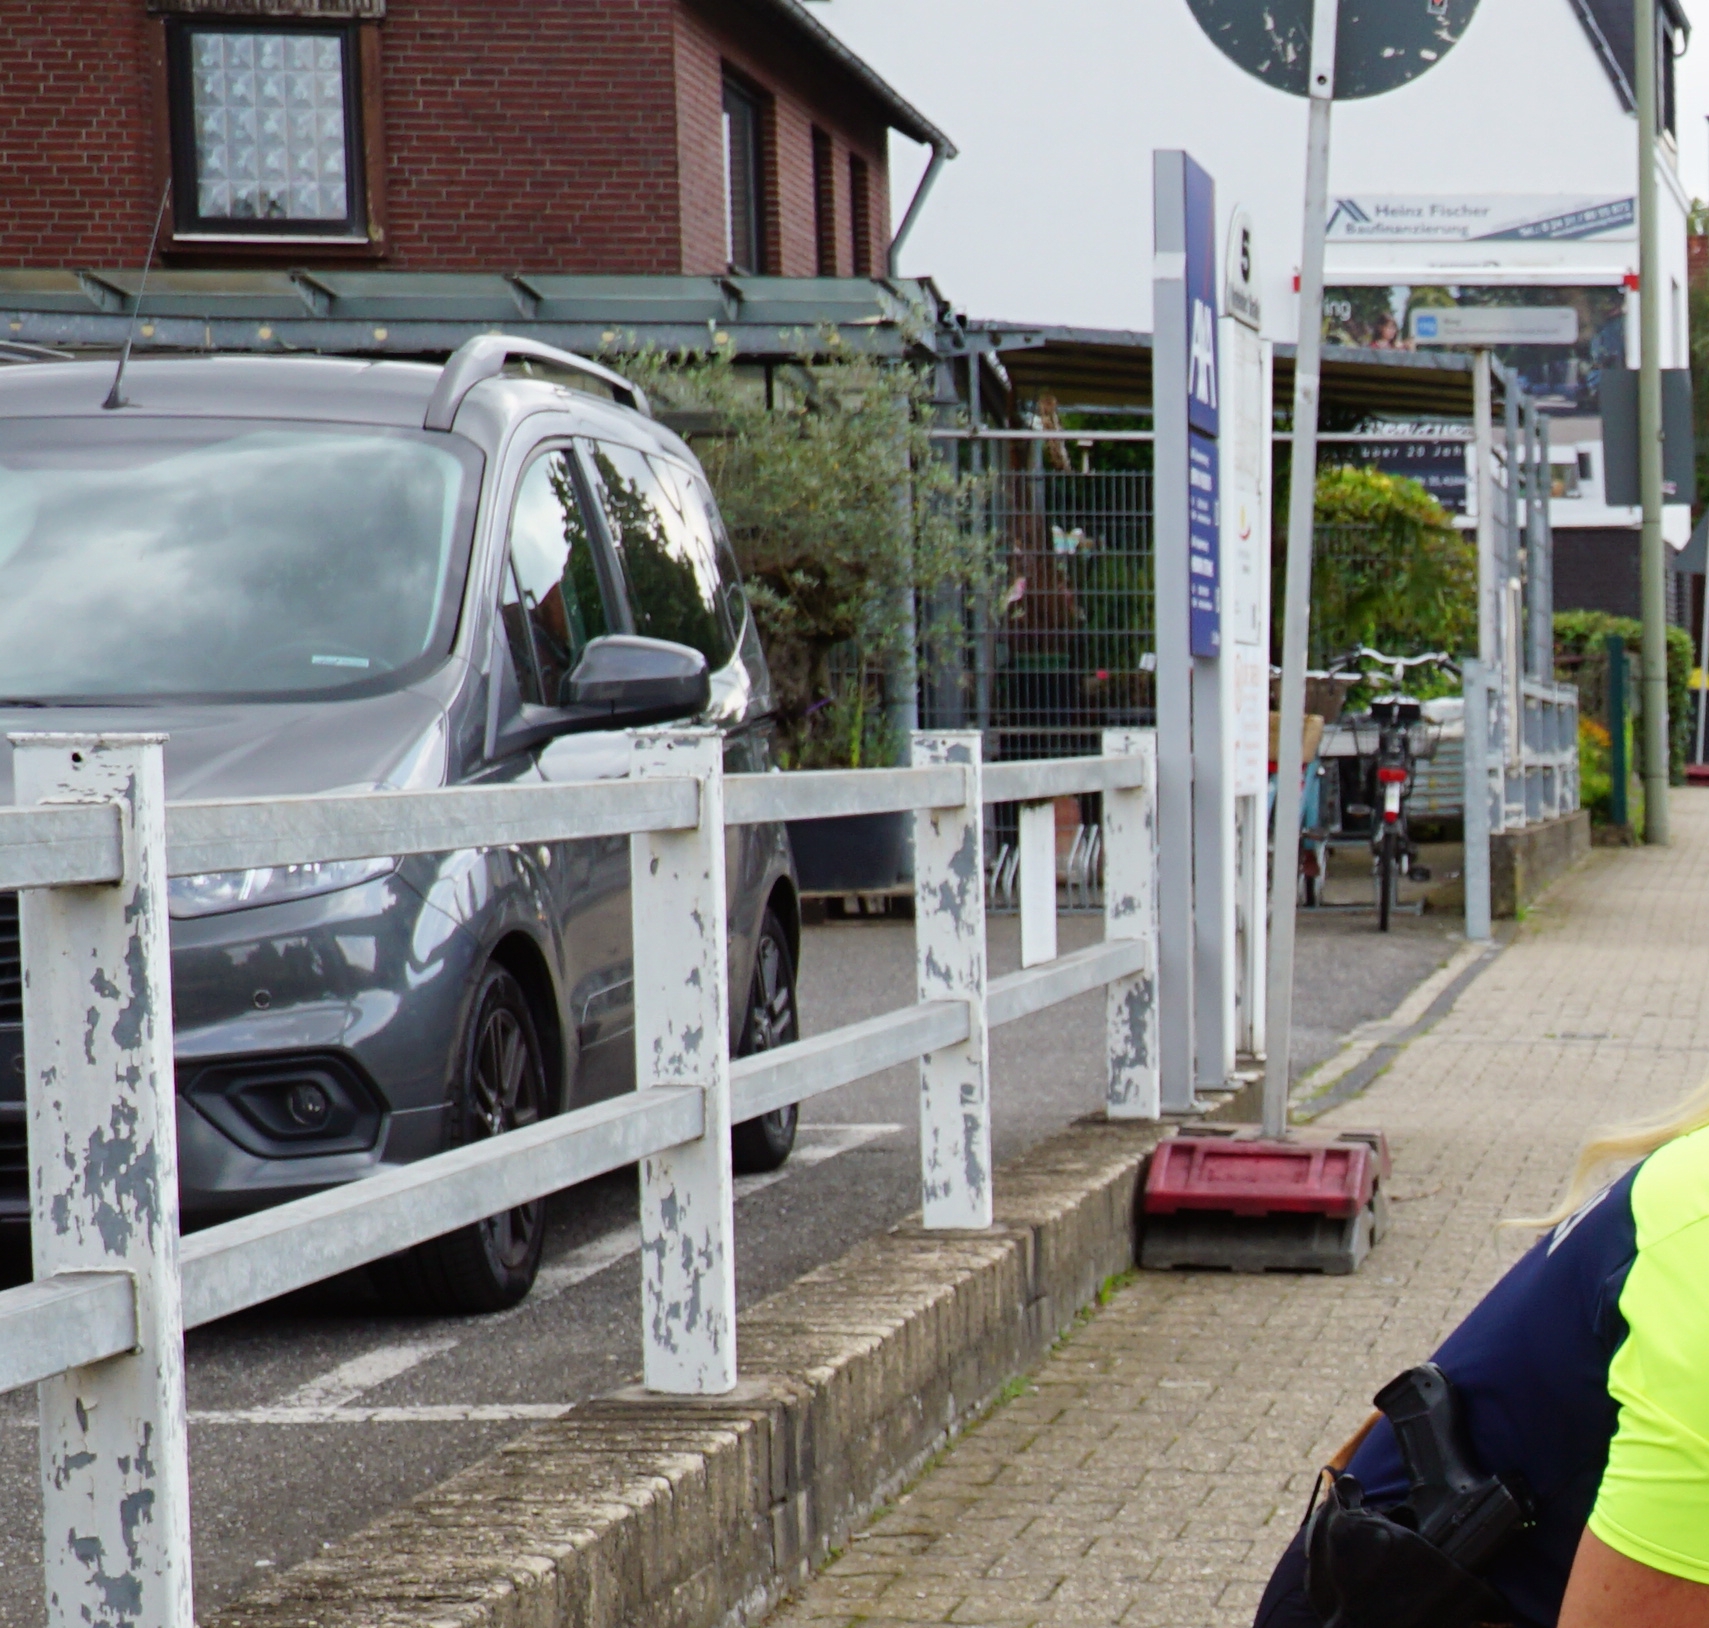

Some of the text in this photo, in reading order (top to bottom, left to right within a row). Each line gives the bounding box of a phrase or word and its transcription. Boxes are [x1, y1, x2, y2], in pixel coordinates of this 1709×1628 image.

[1375, 203, 1490, 218] Heinz Fischer
[1345, 222, 1470, 239] Baufinanzierung
[1240, 227, 1251, 284] 5
[1323, 299, 1351, 322] ing
